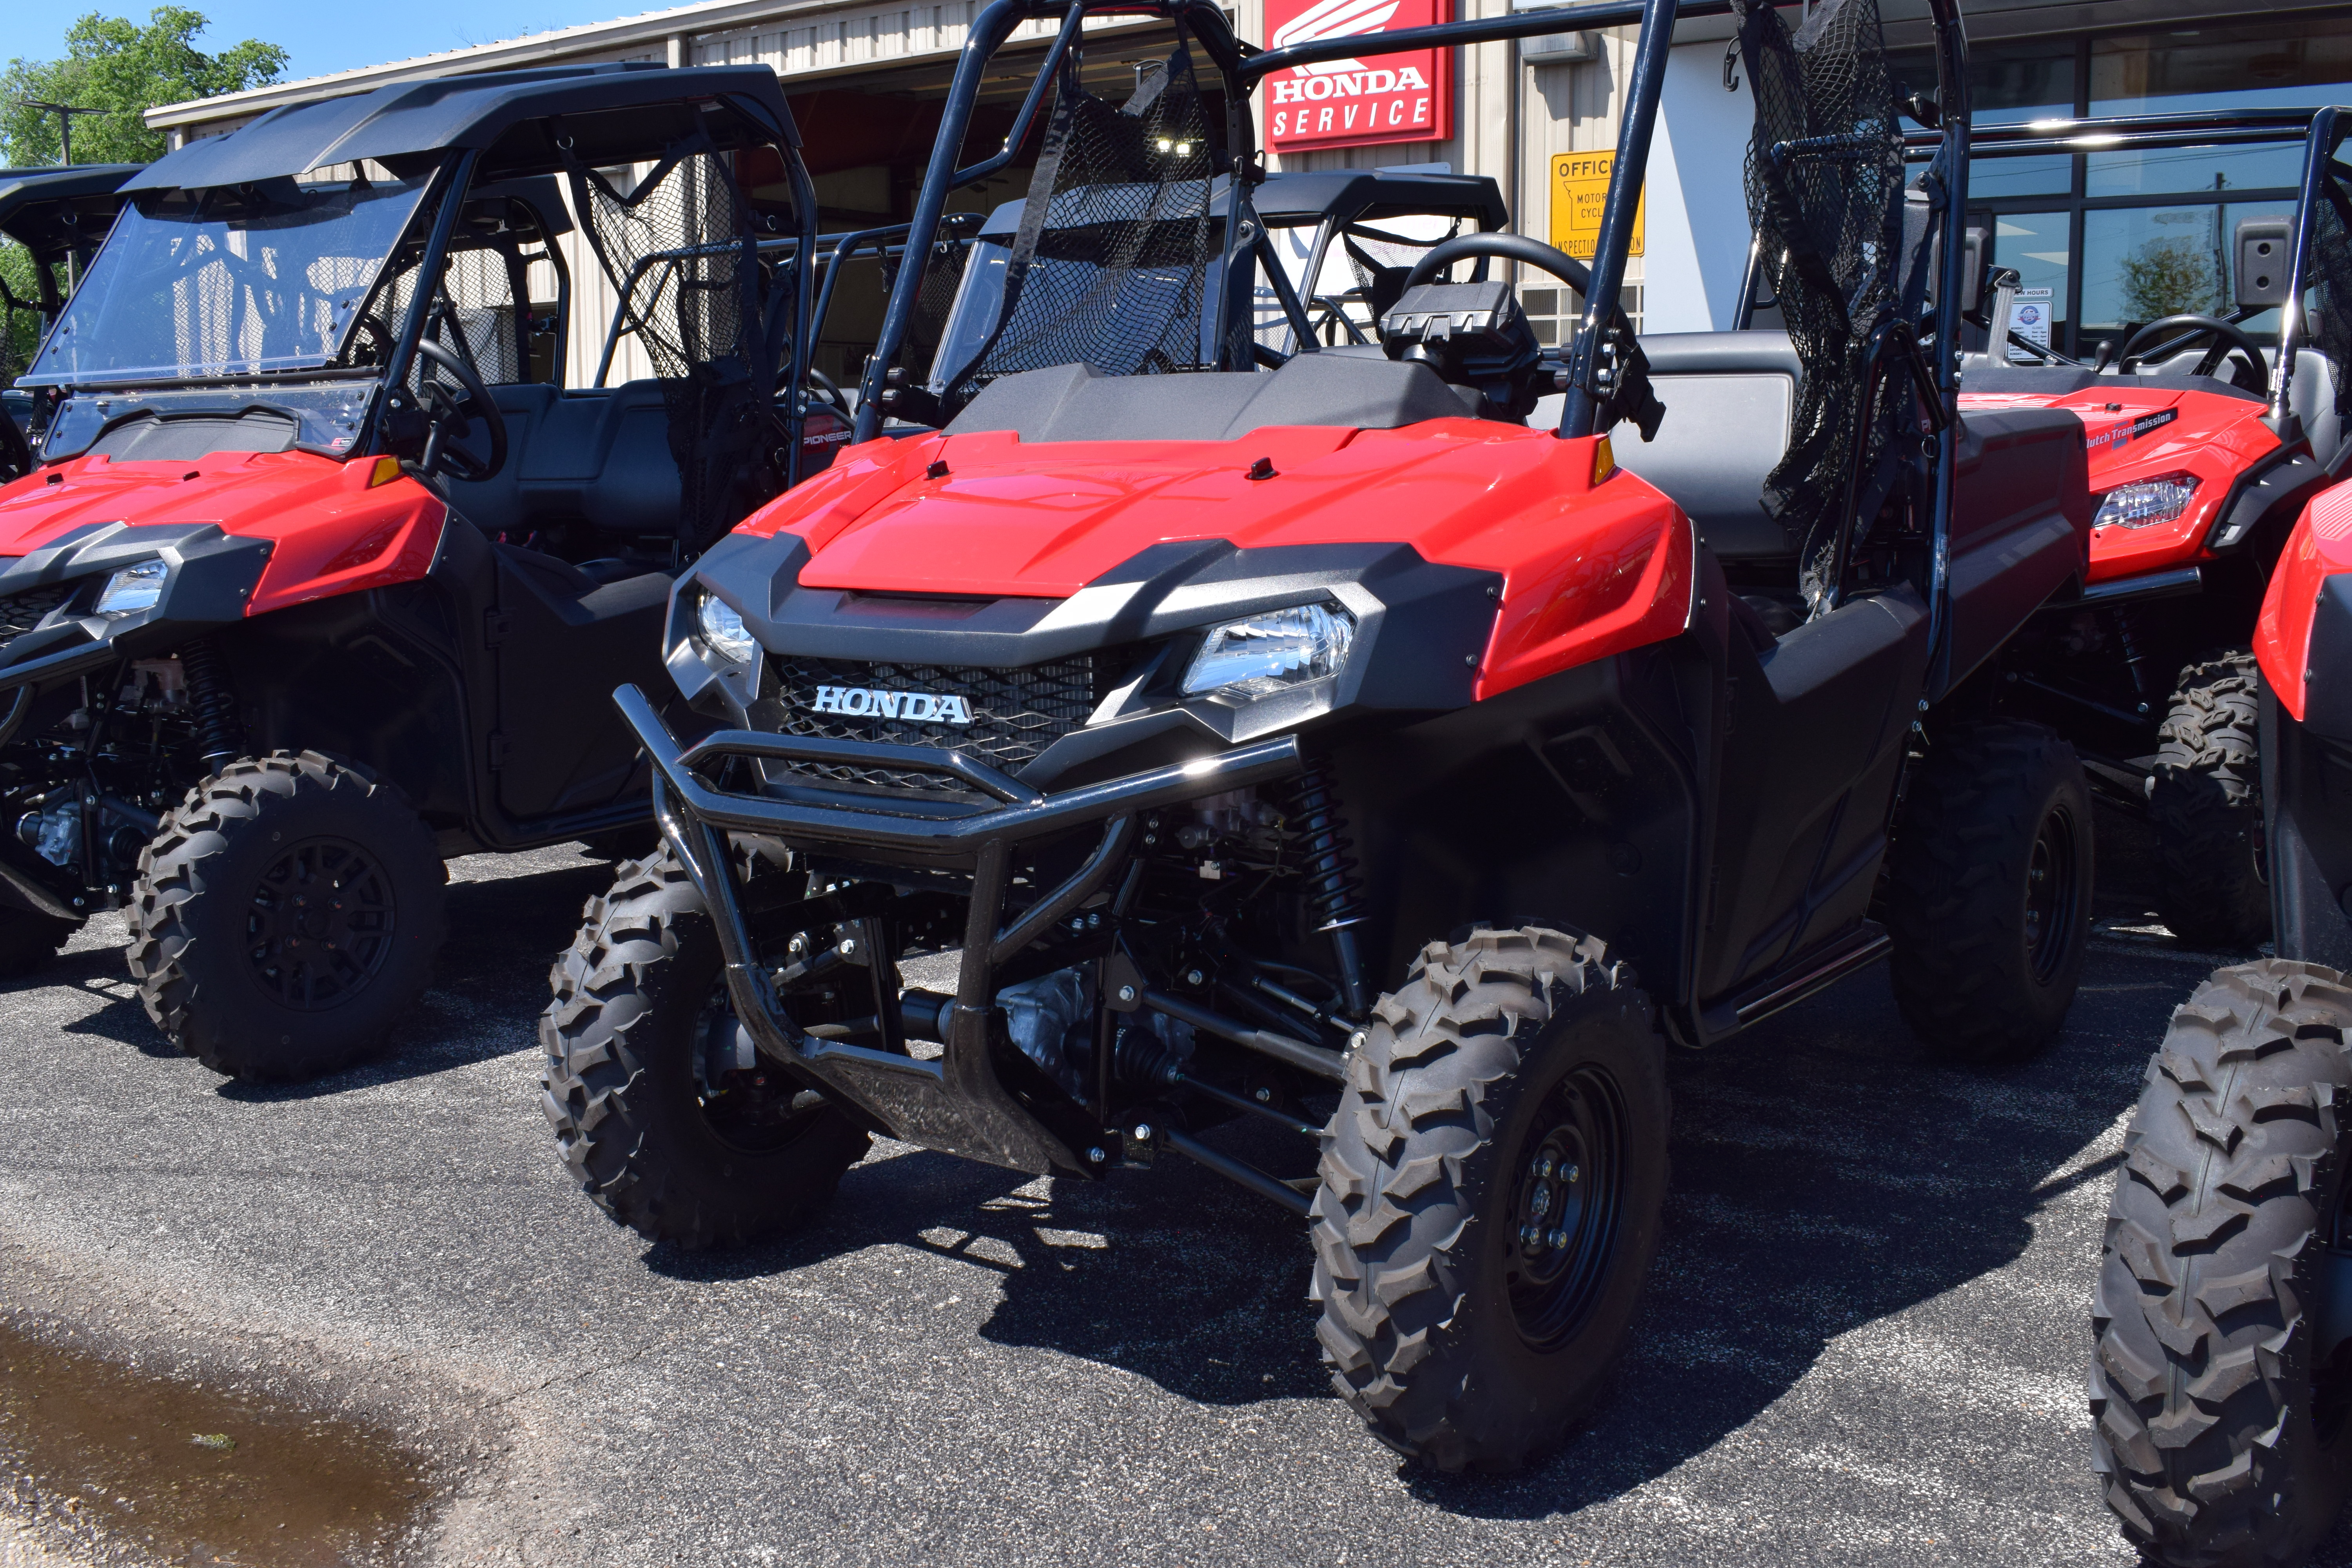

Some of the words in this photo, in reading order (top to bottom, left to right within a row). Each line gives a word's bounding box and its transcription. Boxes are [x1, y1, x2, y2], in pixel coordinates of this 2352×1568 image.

[1273, 67, 1429, 104] HONDA
[1273, 98, 1428, 136] SERVICE
[1581, 208, 1604, 218] CYCL
[804, 430, 852, 446] PIONEER
[2086, 430, 2110, 449] lutch
[2111, 413, 2171, 440] Transmission
[812, 685, 974, 724] HONDA
